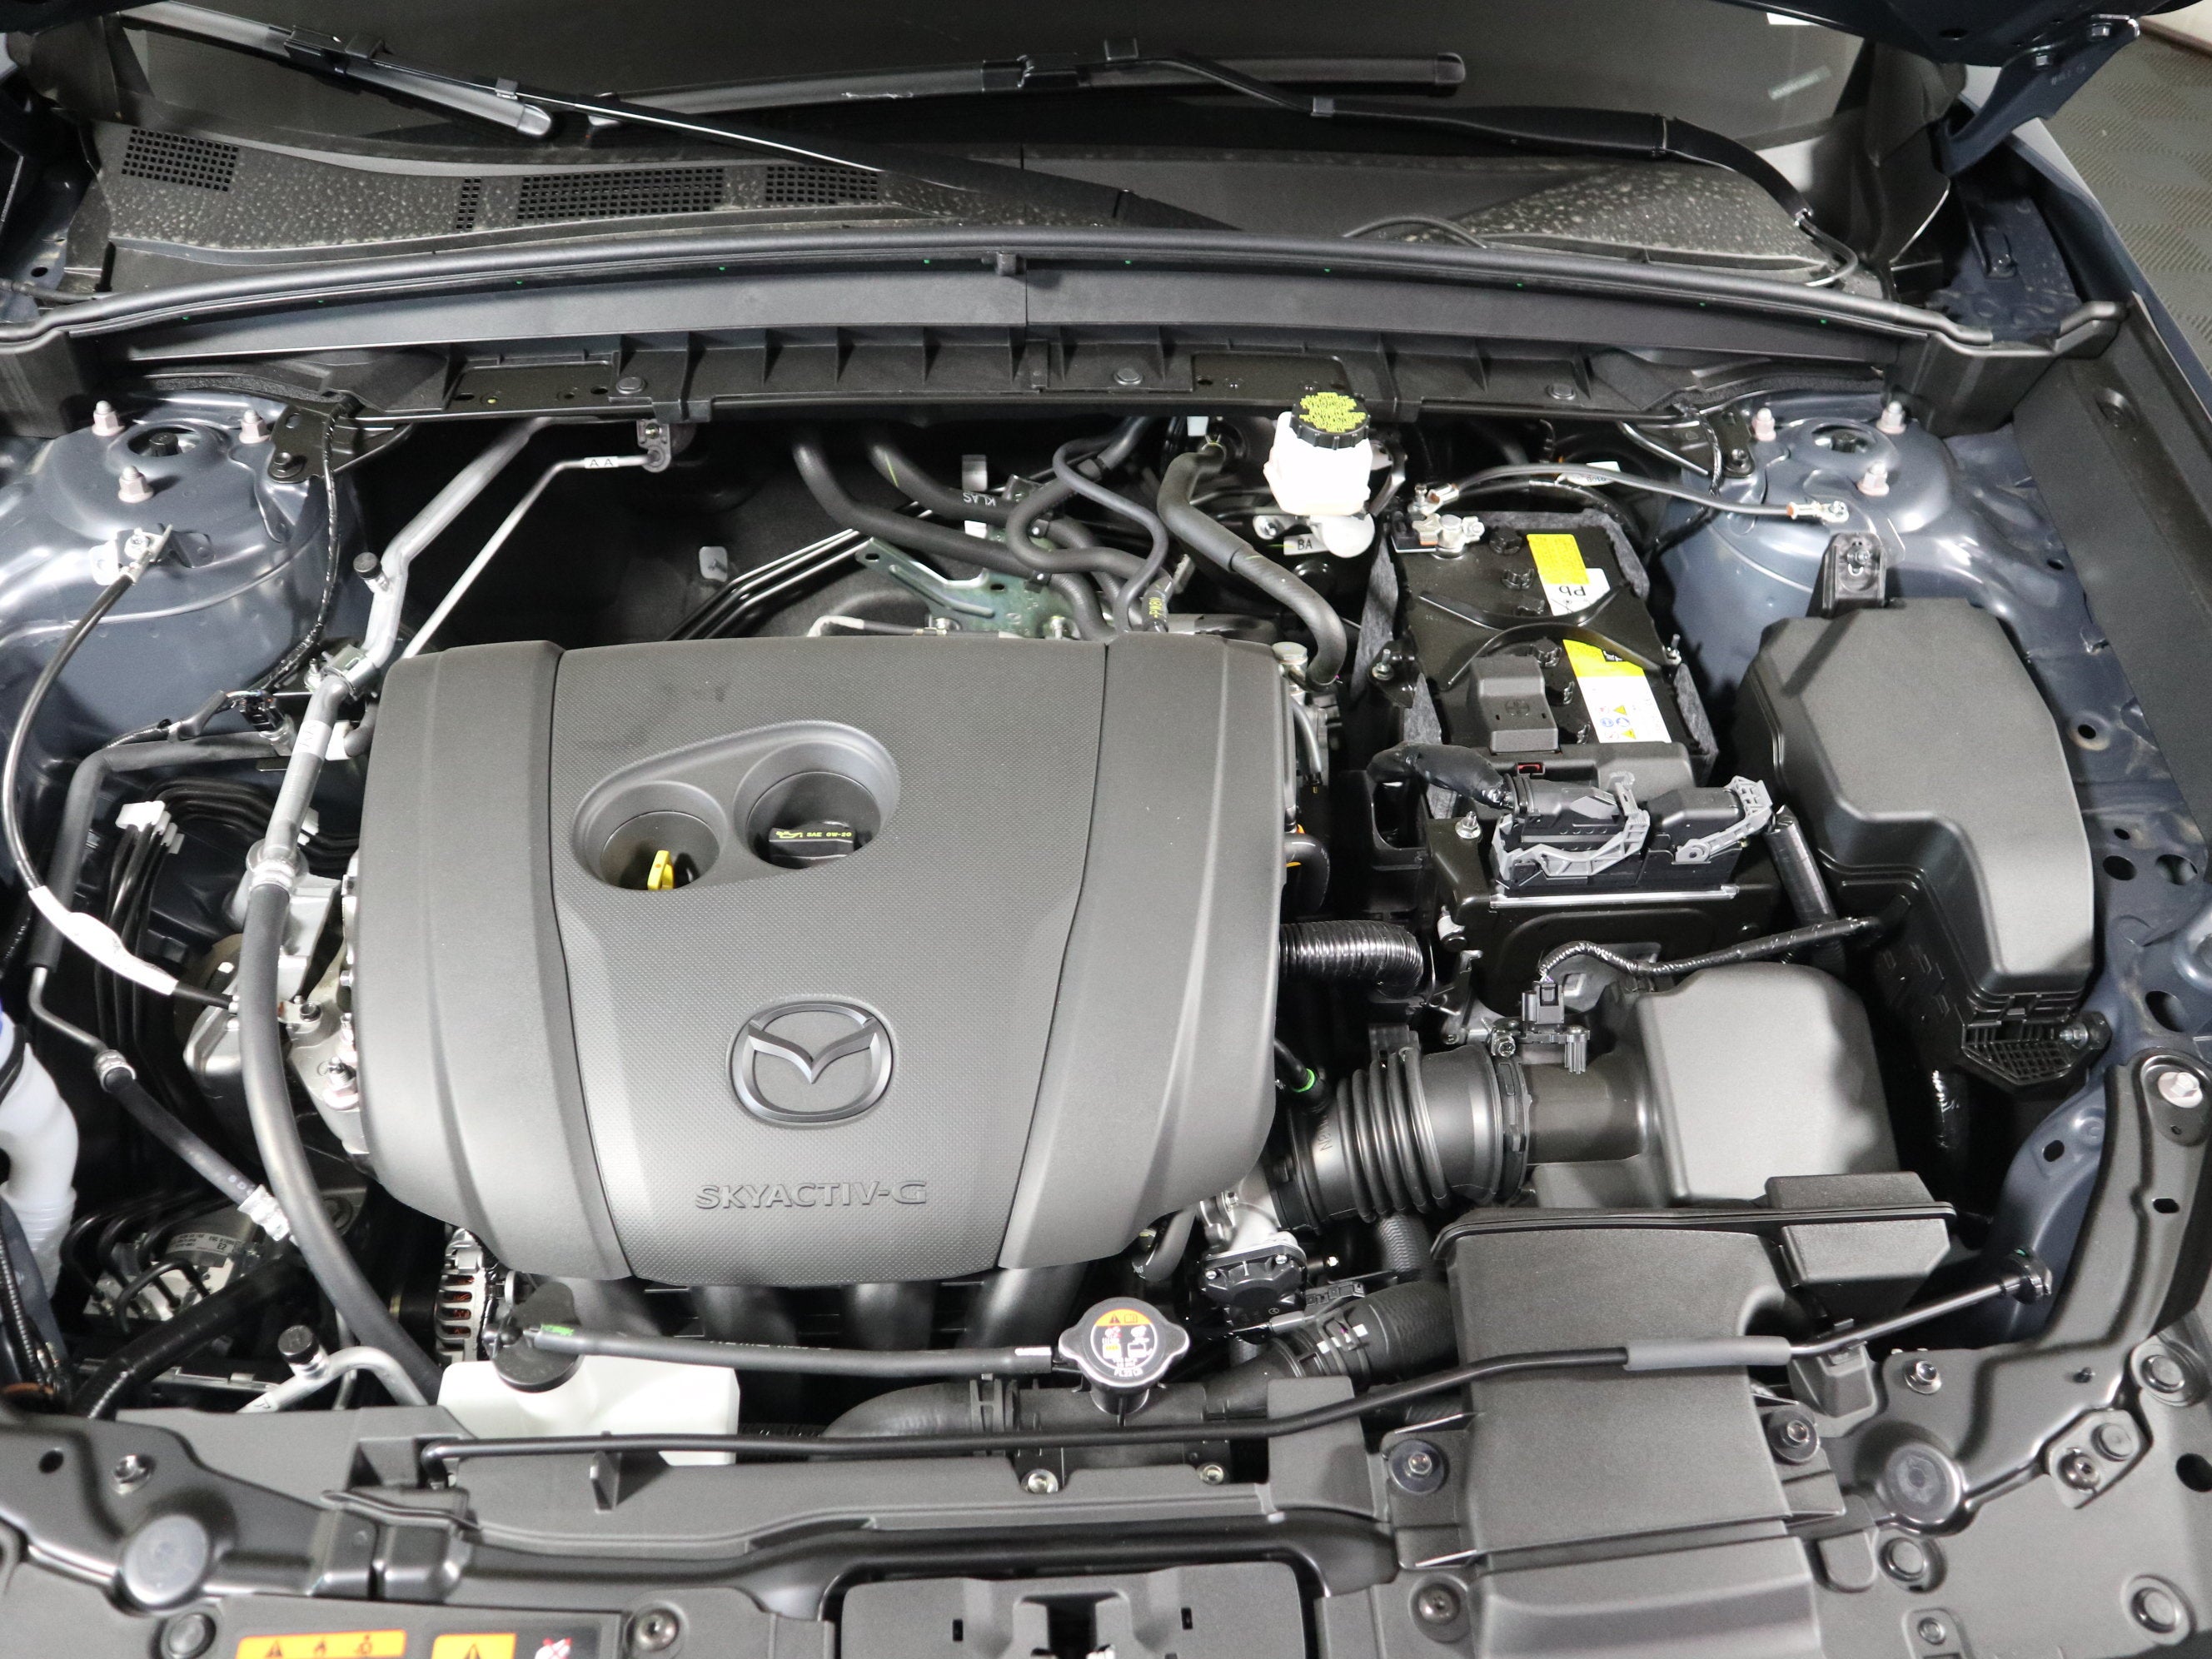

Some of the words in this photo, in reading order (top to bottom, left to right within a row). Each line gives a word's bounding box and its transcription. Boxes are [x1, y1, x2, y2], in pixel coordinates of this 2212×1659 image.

[1298, 539, 1313, 551] BA
[1559, 585, 1587, 596] Pb
[695, 1181, 927, 1209] SKYACTIV-G
